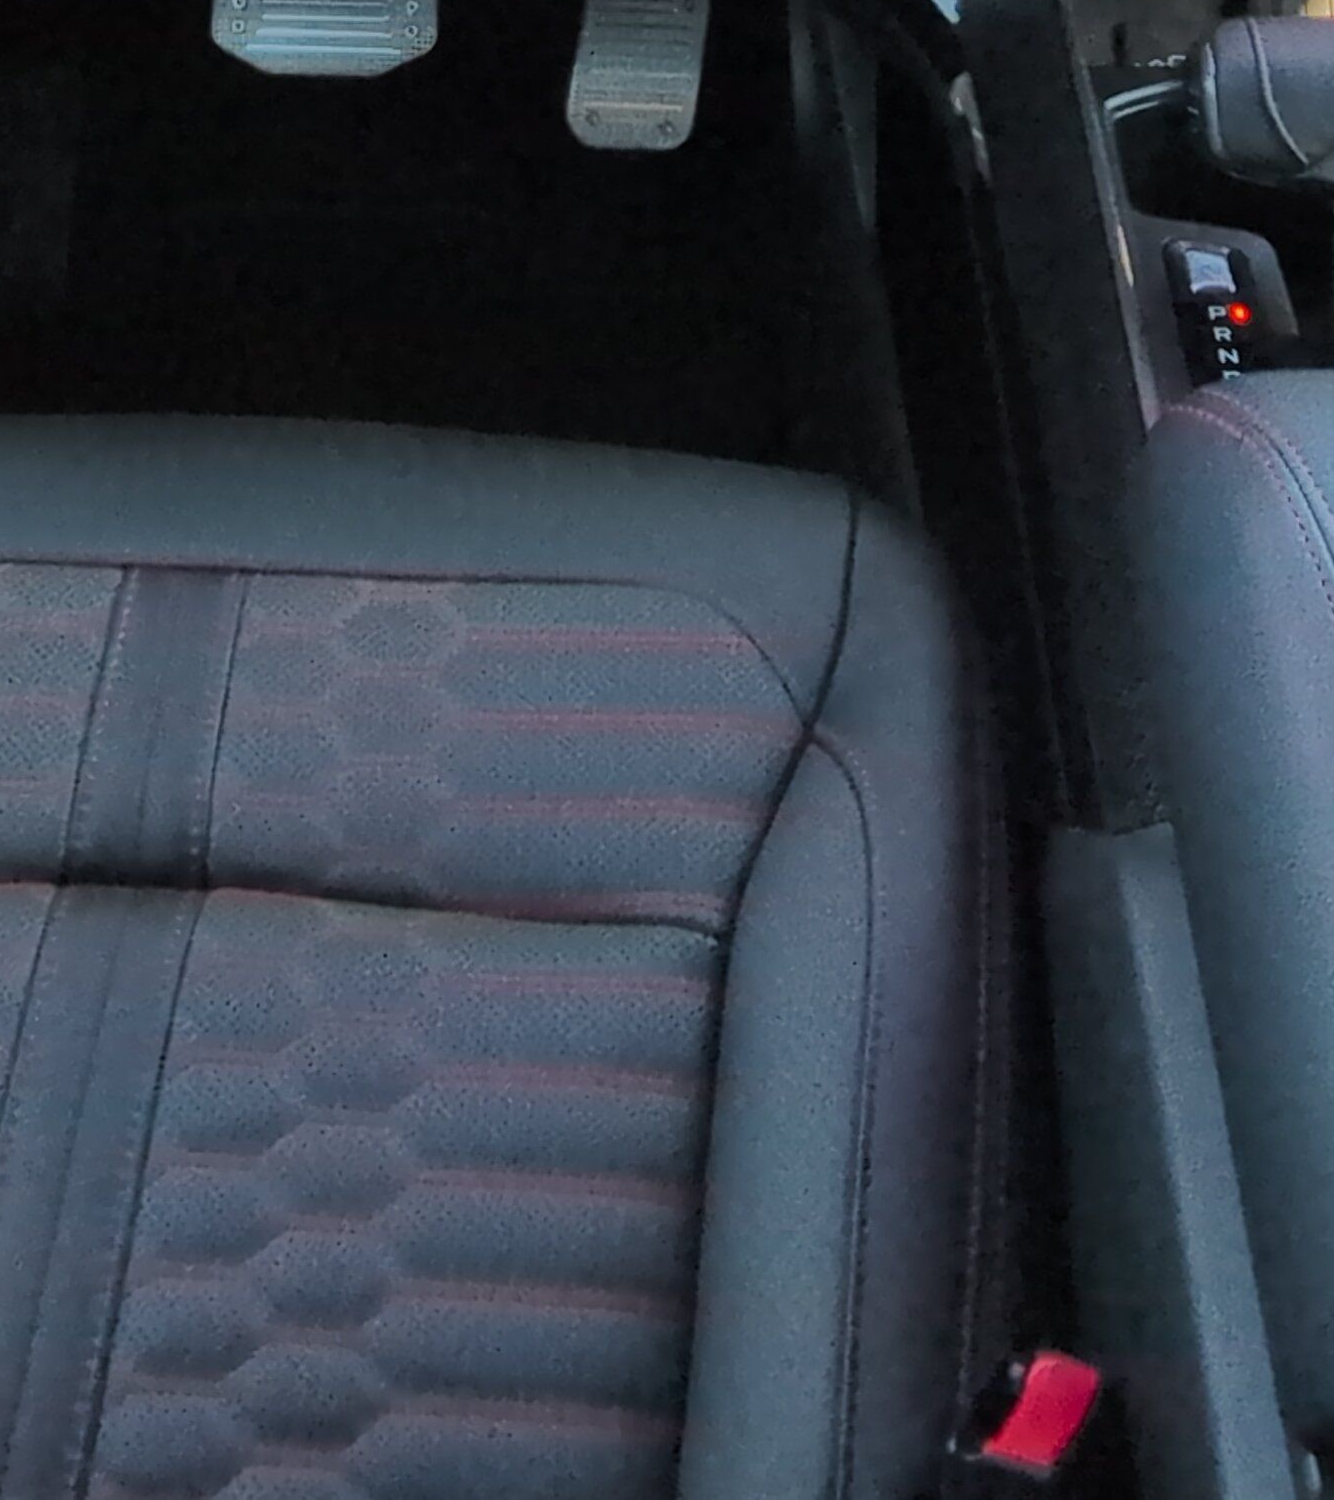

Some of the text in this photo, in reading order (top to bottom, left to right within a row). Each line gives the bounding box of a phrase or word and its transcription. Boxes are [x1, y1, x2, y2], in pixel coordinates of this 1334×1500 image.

[1208, 306, 1227, 320] P
[1212, 327, 1232, 341] R
[1218, 348, 1240, 364] N
